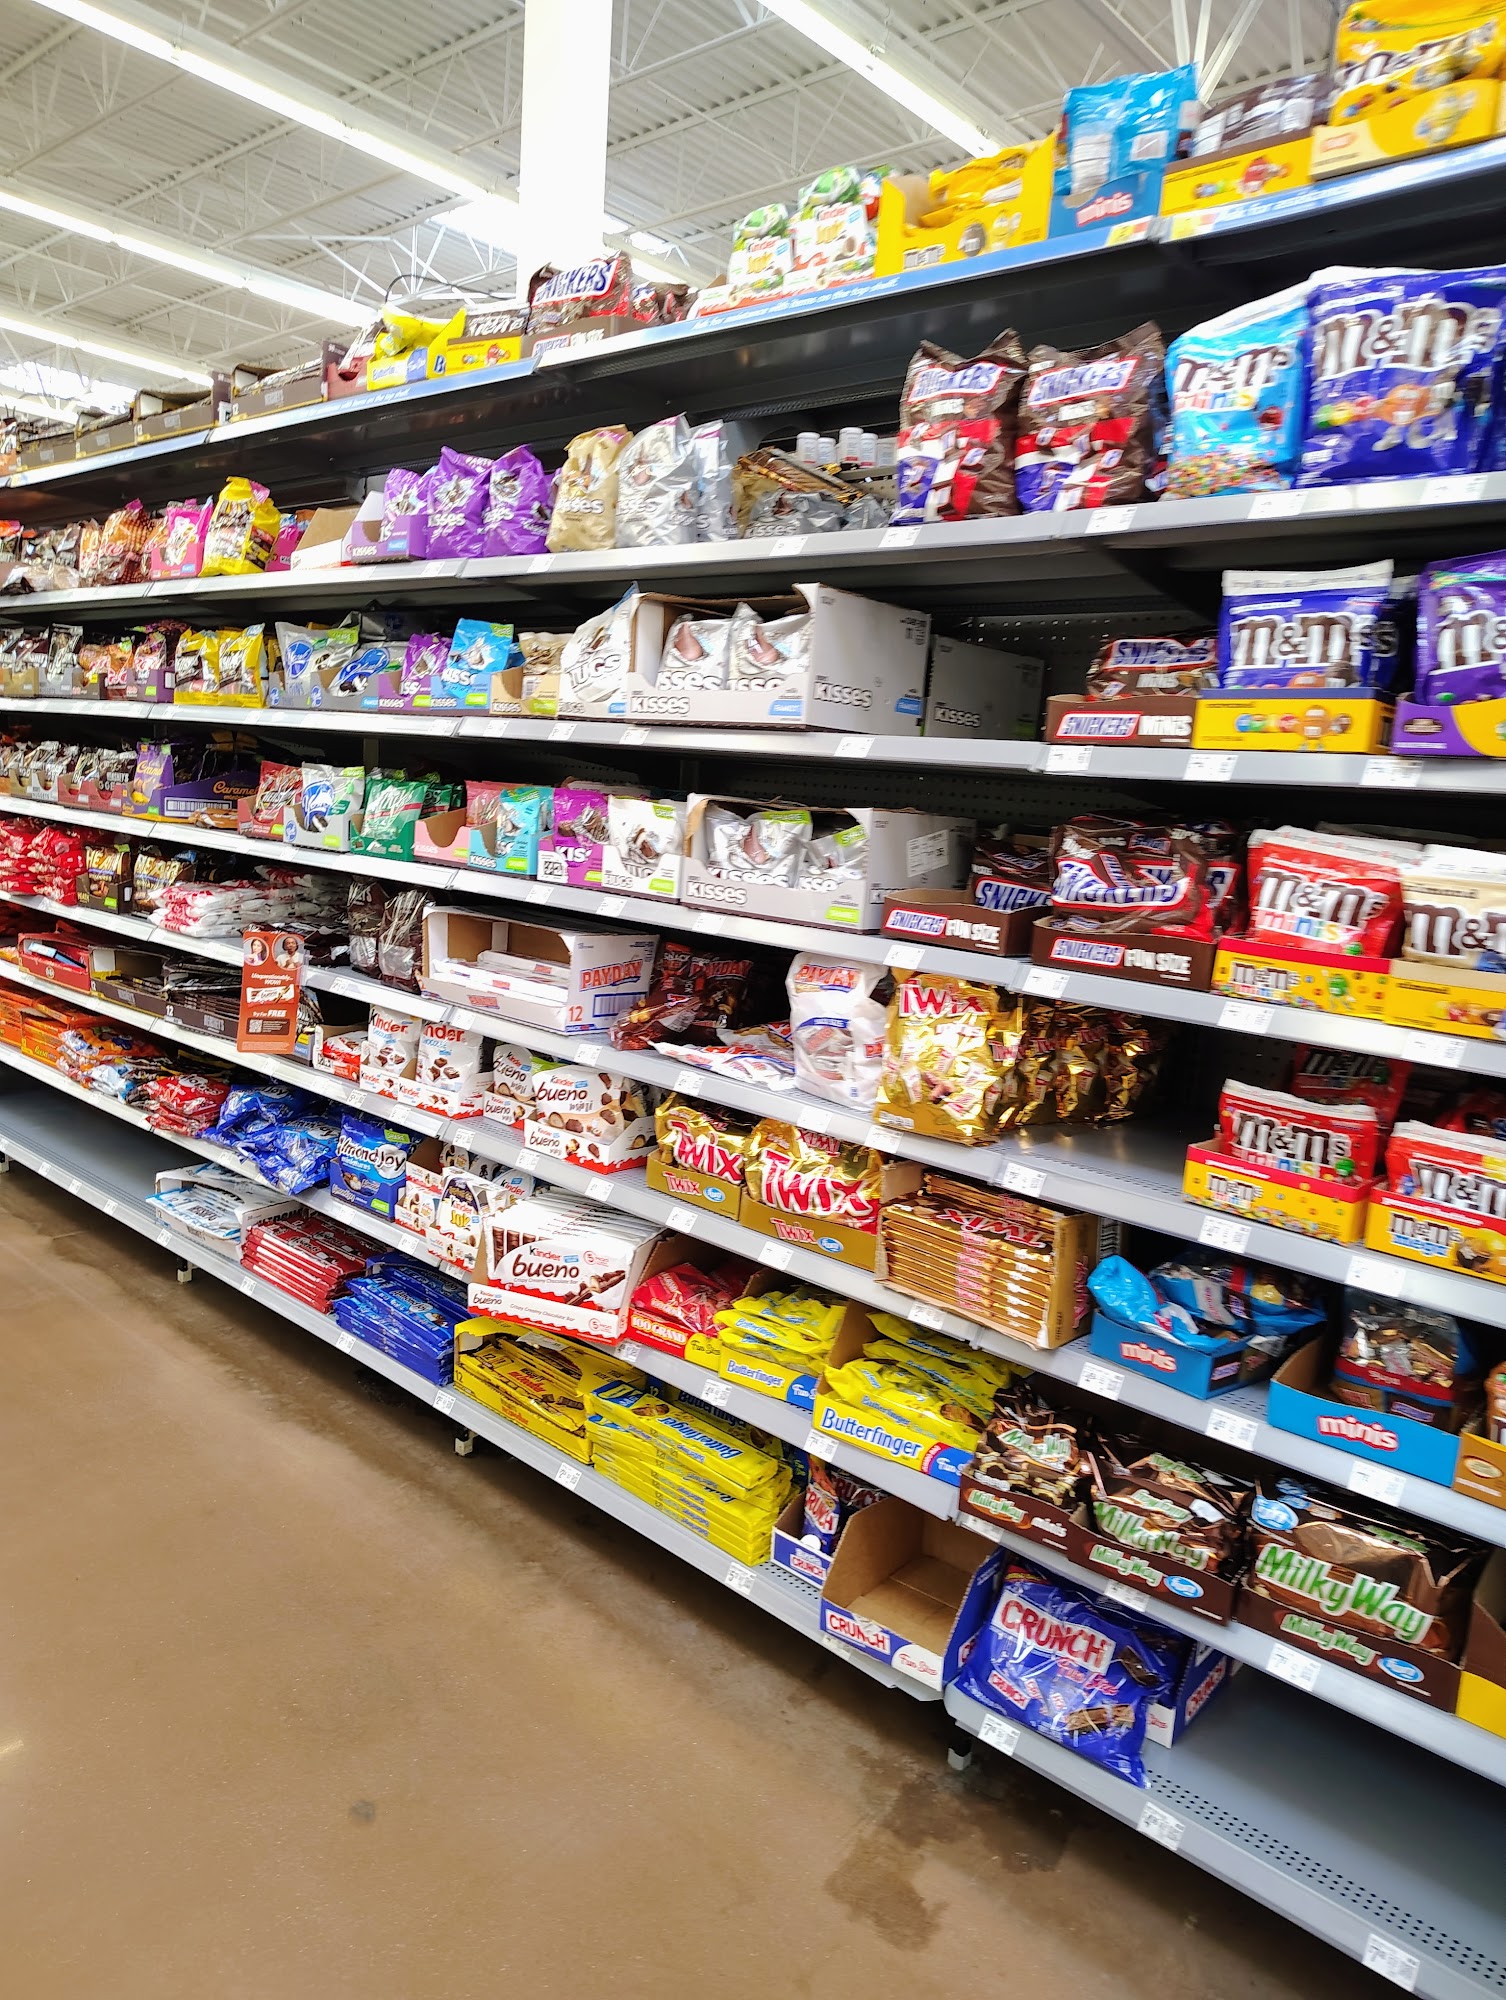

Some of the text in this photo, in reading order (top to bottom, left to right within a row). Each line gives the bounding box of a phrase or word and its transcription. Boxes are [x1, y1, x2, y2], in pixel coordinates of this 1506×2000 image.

[1076, 191, 1134, 228] minis
[555, 846, 591, 863] KIS
[888, 911, 946, 935] SNICKERS
[1055, 940, 1122, 965] SNICKERS
[580, 960, 644, 991] PAYDAY
[267, 1009, 288, 1018] FREE
[568, 1005, 584, 1023] 12
[535, 1081, 589, 1101] bueno
[485, 1099, 511, 1115] bueno
[529, 1133, 560, 1148] bueno
[512, 1253, 580, 1279] bueno
[473, 1294, 503, 1306] bueno
[630, 1314, 688, 1344] 100 GRAND
[1120, 1341, 1178, 1374] minis
[455, 1369, 465, 1384] 12
[727, 1358, 785, 1388] Butterfinger
[657, 1417, 743, 1459] Butterfinger
[822, 1407, 924, 1459] Butterfinger
[1317, 1414, 1400, 1452] minis
[1257, 1544, 1432, 1643] Milky Way
[1000, 1599, 1112, 1672] CRUNCH
